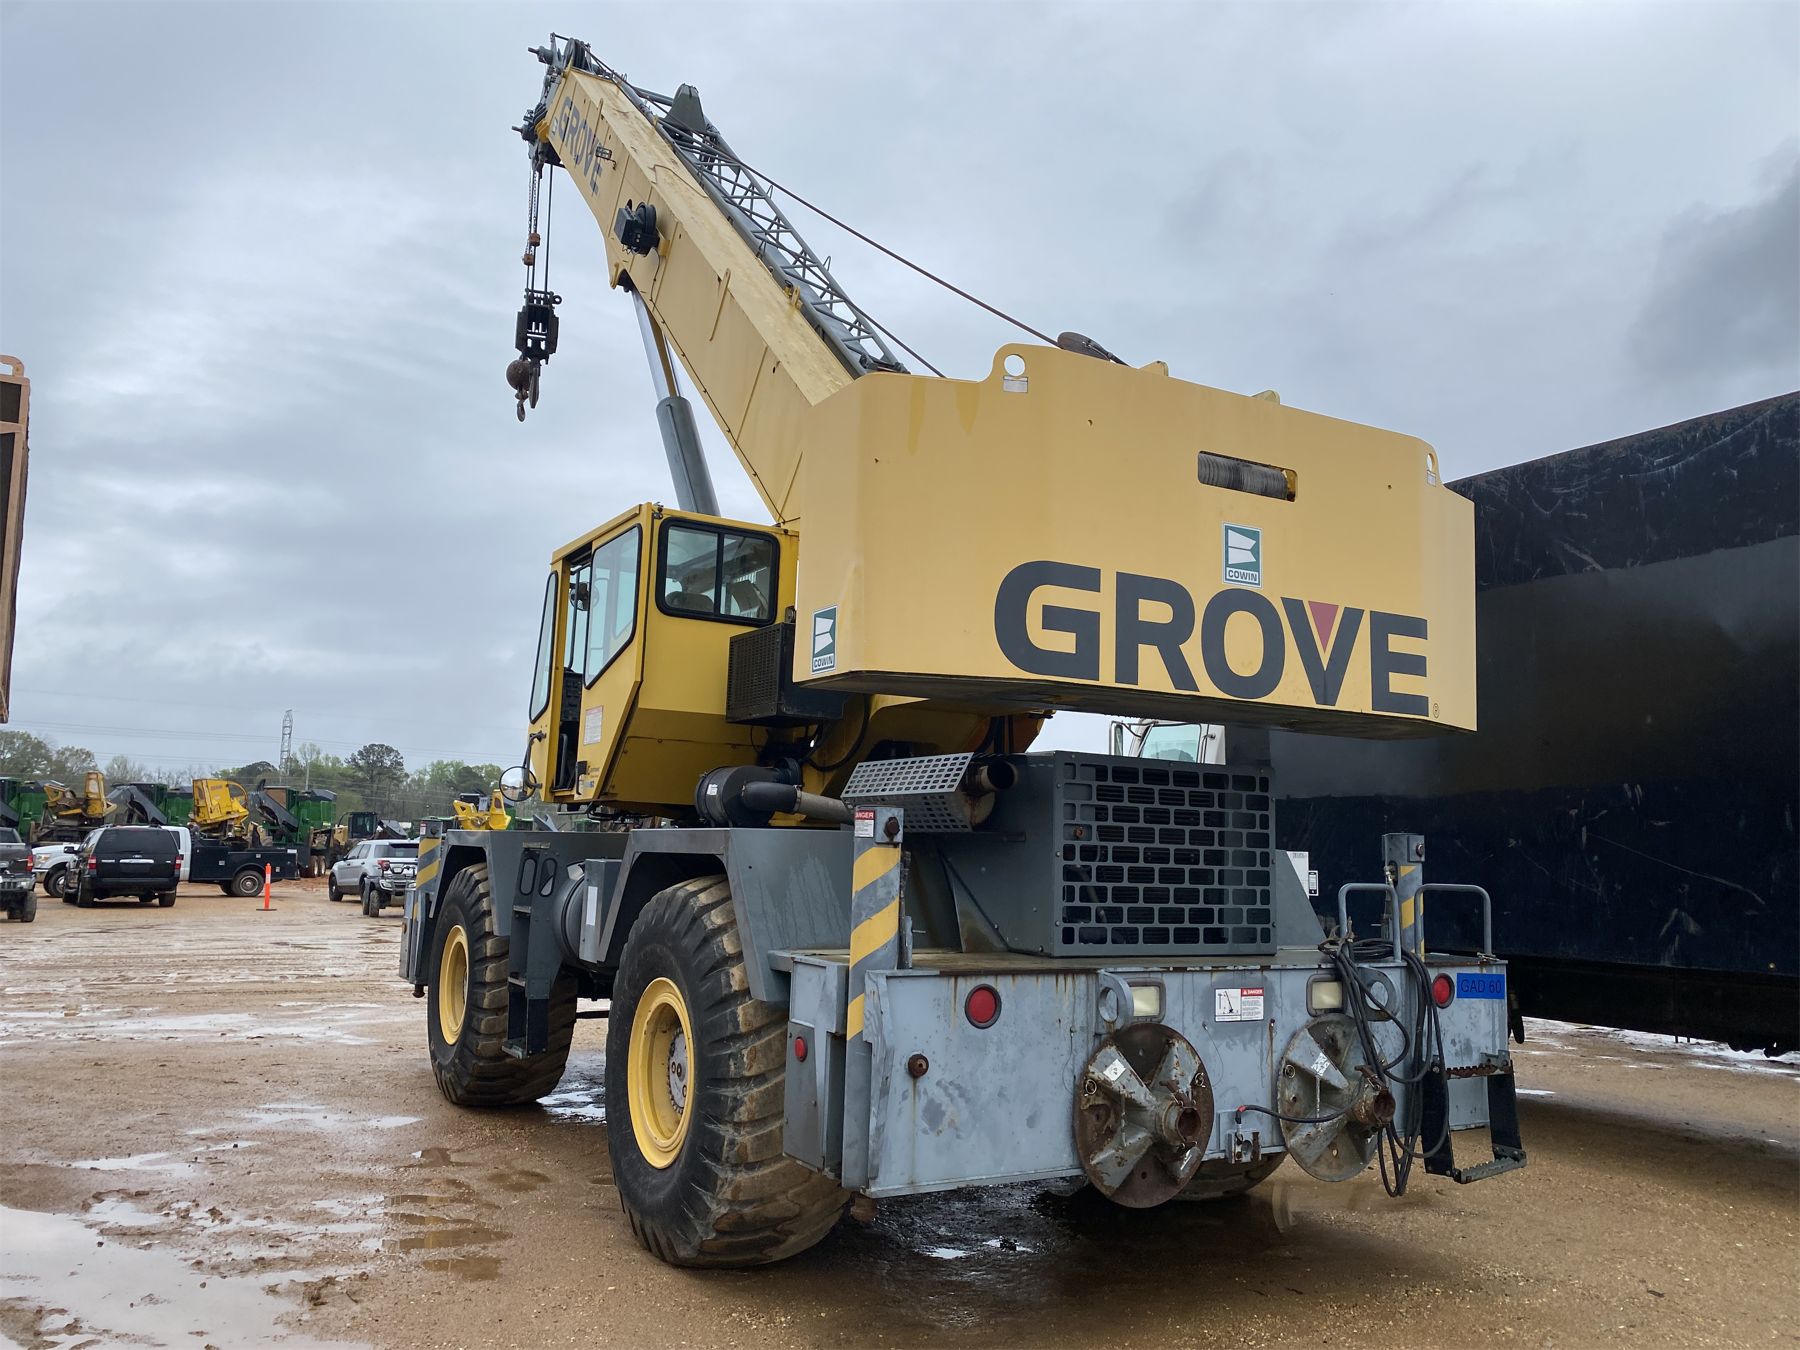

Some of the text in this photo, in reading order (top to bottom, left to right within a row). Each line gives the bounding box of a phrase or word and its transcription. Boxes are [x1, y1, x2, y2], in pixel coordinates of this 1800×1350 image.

[559, 96, 602, 196] GROVE
[1228, 569, 1258, 582] COWIN
[994, 560, 1430, 717] GROVE
[813, 655, 833, 668] COWIN
[1461, 979, 1502, 994] GAD 60
